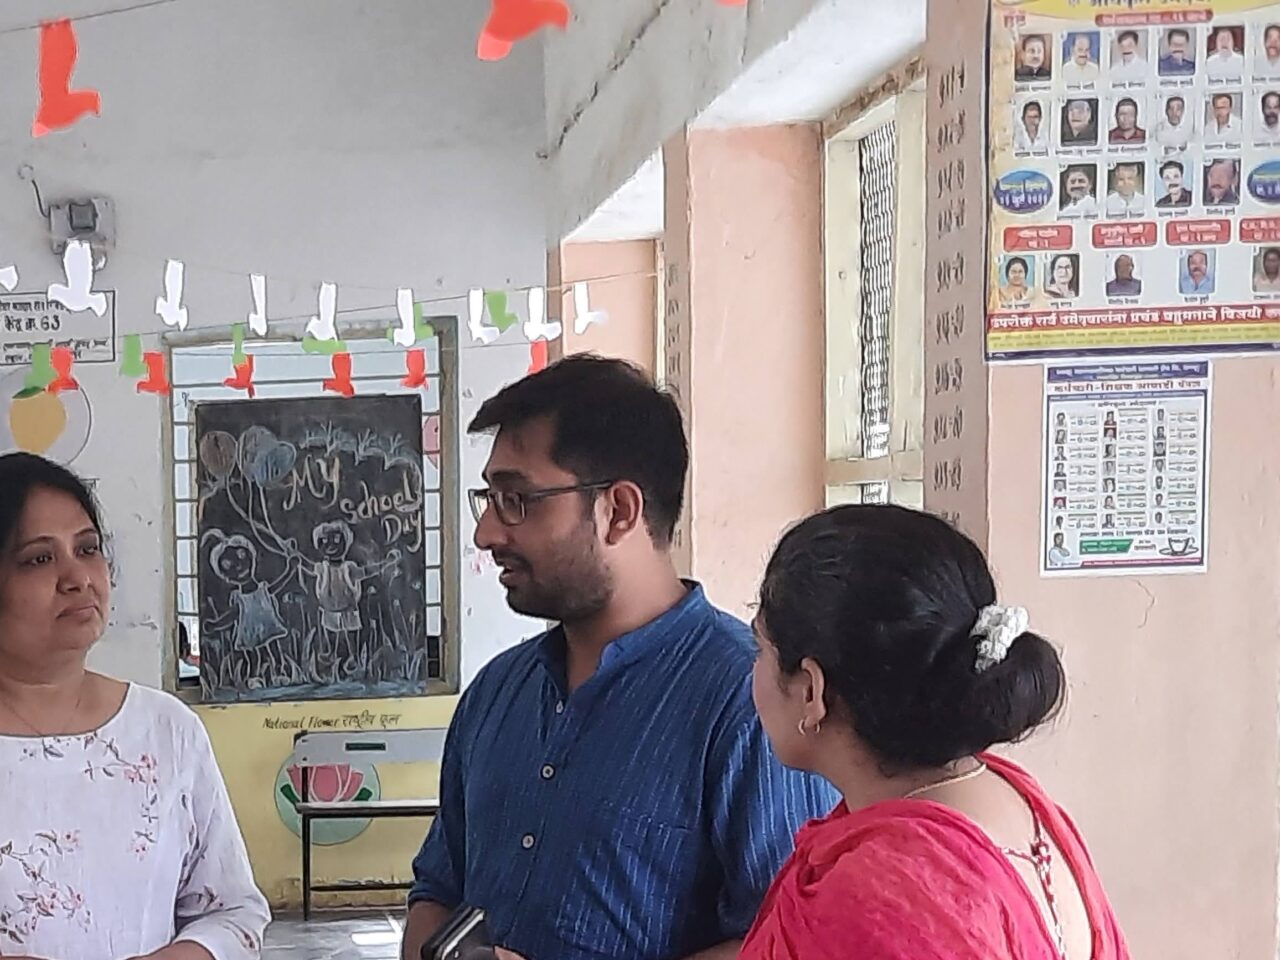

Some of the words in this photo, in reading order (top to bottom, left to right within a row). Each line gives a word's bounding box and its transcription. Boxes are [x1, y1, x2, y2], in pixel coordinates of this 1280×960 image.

[283, 455, 340, 511] My
[380, 511, 422, 552] Day
[262, 716, 304, 730] National
